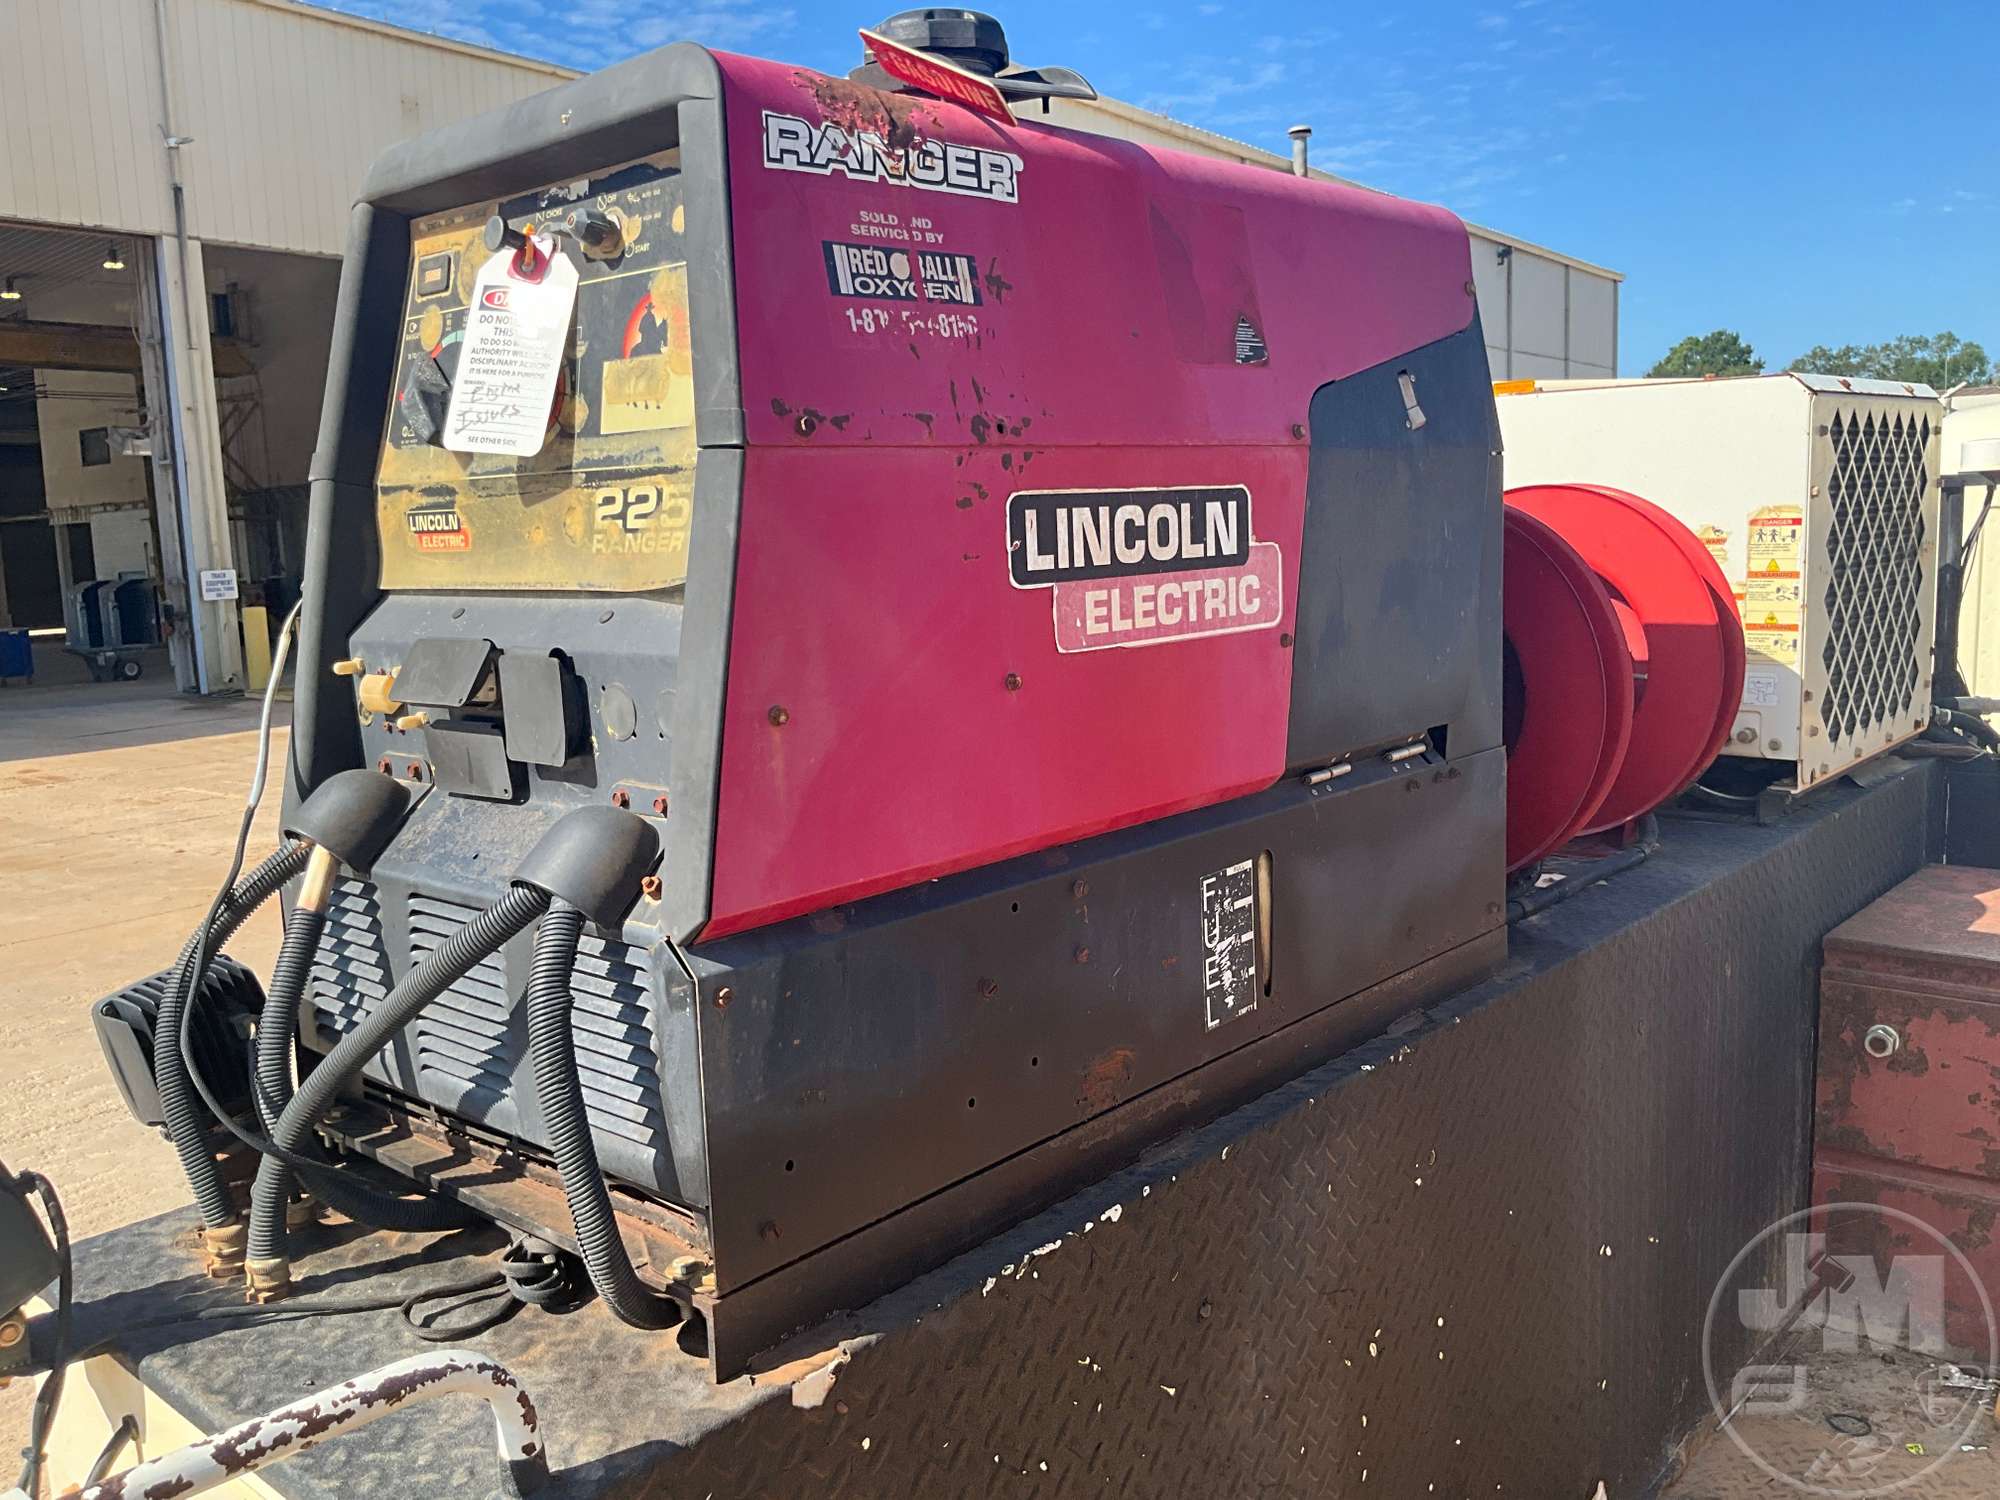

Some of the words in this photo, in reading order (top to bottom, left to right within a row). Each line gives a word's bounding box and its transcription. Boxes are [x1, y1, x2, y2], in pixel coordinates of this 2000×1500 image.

[888, 51, 1003, 115] GASOLINE
[762, 110, 1024, 203] RANGER
[860, 211, 898, 225] SOLD
[908, 217, 932, 229] ND
[925, 232, 944, 244] BY
[848, 248, 888, 276] RED
[480, 314, 494, 324] DO
[494, 327, 514, 337] THIS
[480, 337, 489, 346] TO
[490, 338, 501, 346] DO
[502, 339, 513, 347] SO
[471, 347, 511, 356] AUTHORITY
[470, 357, 518, 366] DISCIPLINARY
[498, 369, 511, 377] FOR
[480, 437, 501, 445] OTHER
[594, 486, 690, 529] 225
[409, 514, 459, 531] LINCOLN
[422, 535, 465, 548] ELECTRIC
[592, 531, 685, 554] RANGER
[1024, 500, 1239, 571] LINCOLN
[1085, 574, 1261, 635] ELECTRIC
